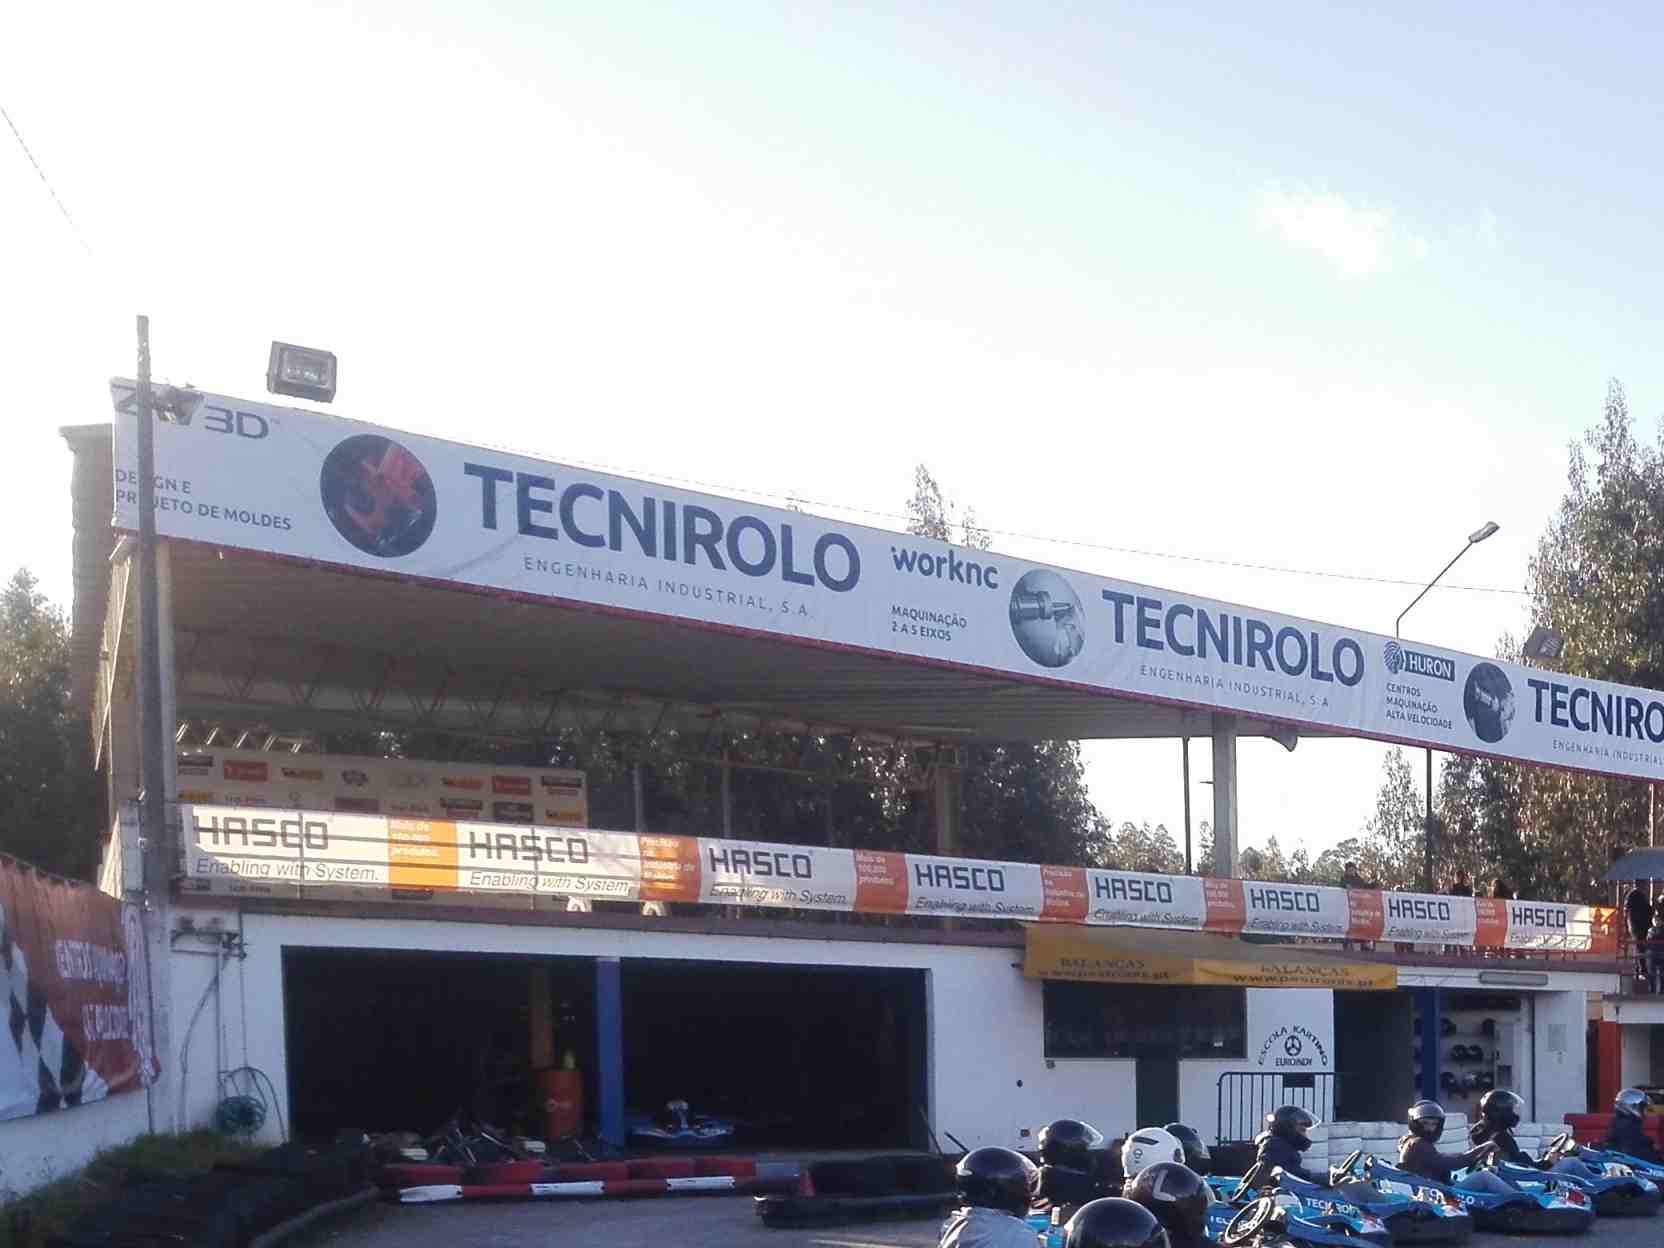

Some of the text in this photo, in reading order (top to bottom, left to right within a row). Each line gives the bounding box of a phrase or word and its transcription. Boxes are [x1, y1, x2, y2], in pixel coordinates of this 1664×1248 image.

[115, 469, 191, 494] DEGN E
[115, 490, 292, 530] PRJETO DE MOLDES
[464, 462, 861, 592] TECNIROLO
[891, 546, 999, 589] worknc
[524, 556, 648, 591] ENGENHARIA
[658, 579, 774, 613] INDUSTRIAL,
[891, 605, 968, 628] MAQUINAÇÃO
[901, 623, 909, 634] A
[911, 624, 917, 635] 5
[920, 626, 952, 641] EIXOS
[1102, 589, 1364, 687] TECNIROLO
[1140, 665, 1224, 689] ENGENHARIA
[1409, 652, 1451, 679] HURON
[1386, 682, 1421, 697] CENTROS
[1386, 697, 1438, 714] MAQUINAÇÃO
[1386, 709, 1452, 730] ALTA VELOCIDADE
[1552, 739, 1610, 758] ENGENHARIA
[193, 815, 329, 850] HASCO
[469, 831, 589, 864] HASCO
[196, 857, 379, 881] Enabling with System.
[708, 847, 812, 879] HASCO
[469, 871, 538, 890] Enabling
[542, 876, 572, 889] with
[914, 863, 1005, 892] HASCO
[1095, 876, 1172, 903] HASCO
[709, 886, 768, 902] Enabling
[772, 886, 797, 901] with
[1250, 888, 1320, 913] HASCO
[1388, 898, 1450, 921] HASCO
[1512, 907, 1567, 929] HASCO
